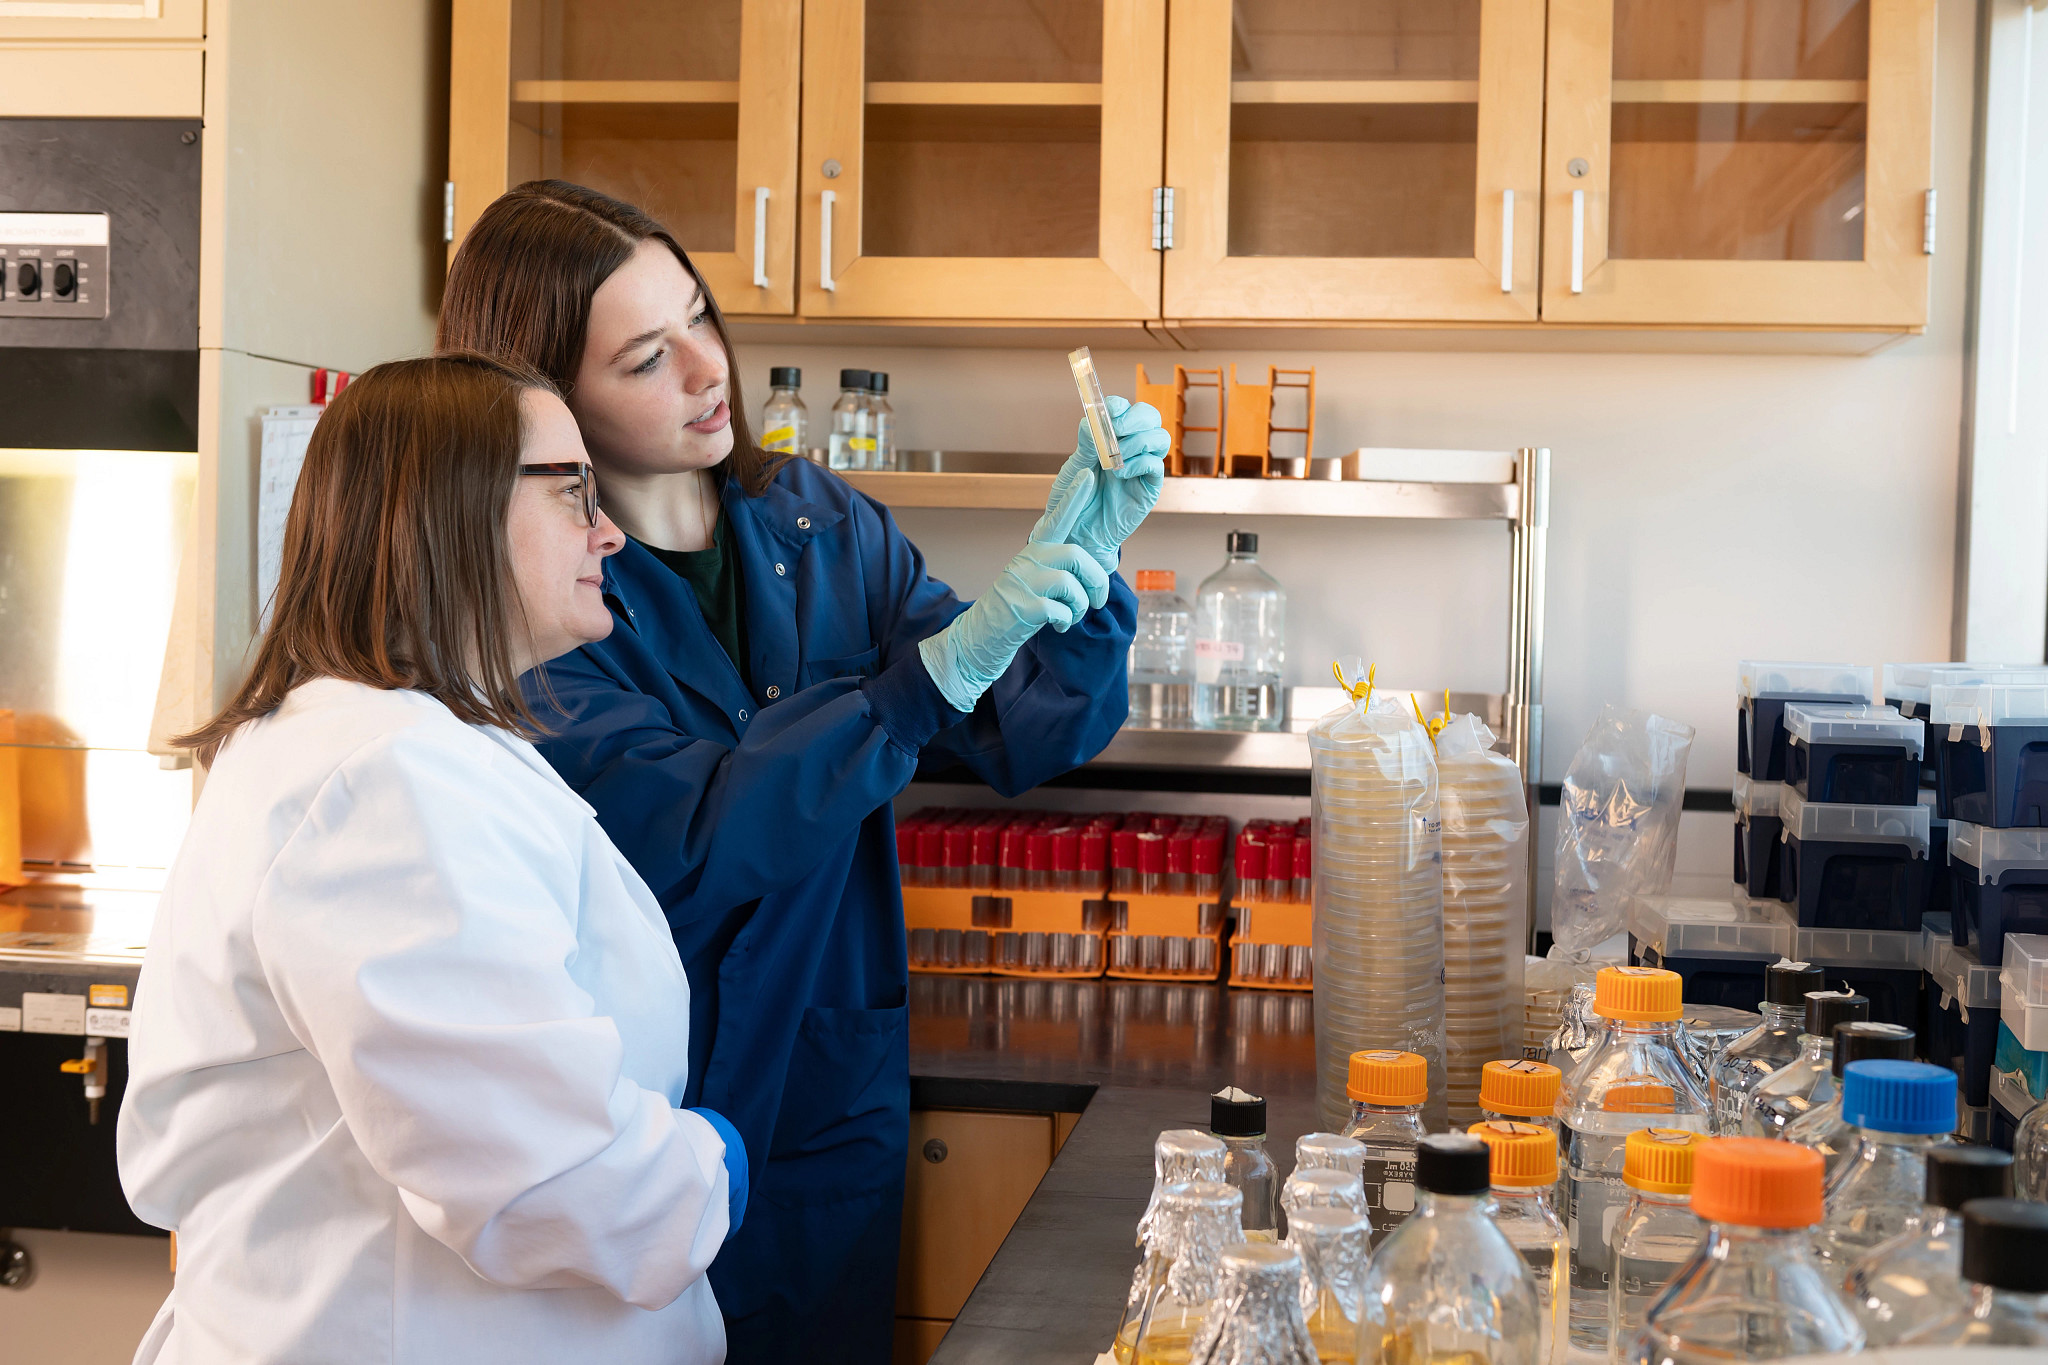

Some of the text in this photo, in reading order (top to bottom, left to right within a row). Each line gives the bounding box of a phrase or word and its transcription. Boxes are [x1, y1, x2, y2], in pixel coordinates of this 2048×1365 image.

[1523, 1047, 1548, 1060] ran
[1730, 1089, 1747, 1100] 1000
[1728, 1109, 1742, 1121] 900
[1604, 1177, 1625, 1186] 100
[1609, 1188, 1630, 1197] PYR
